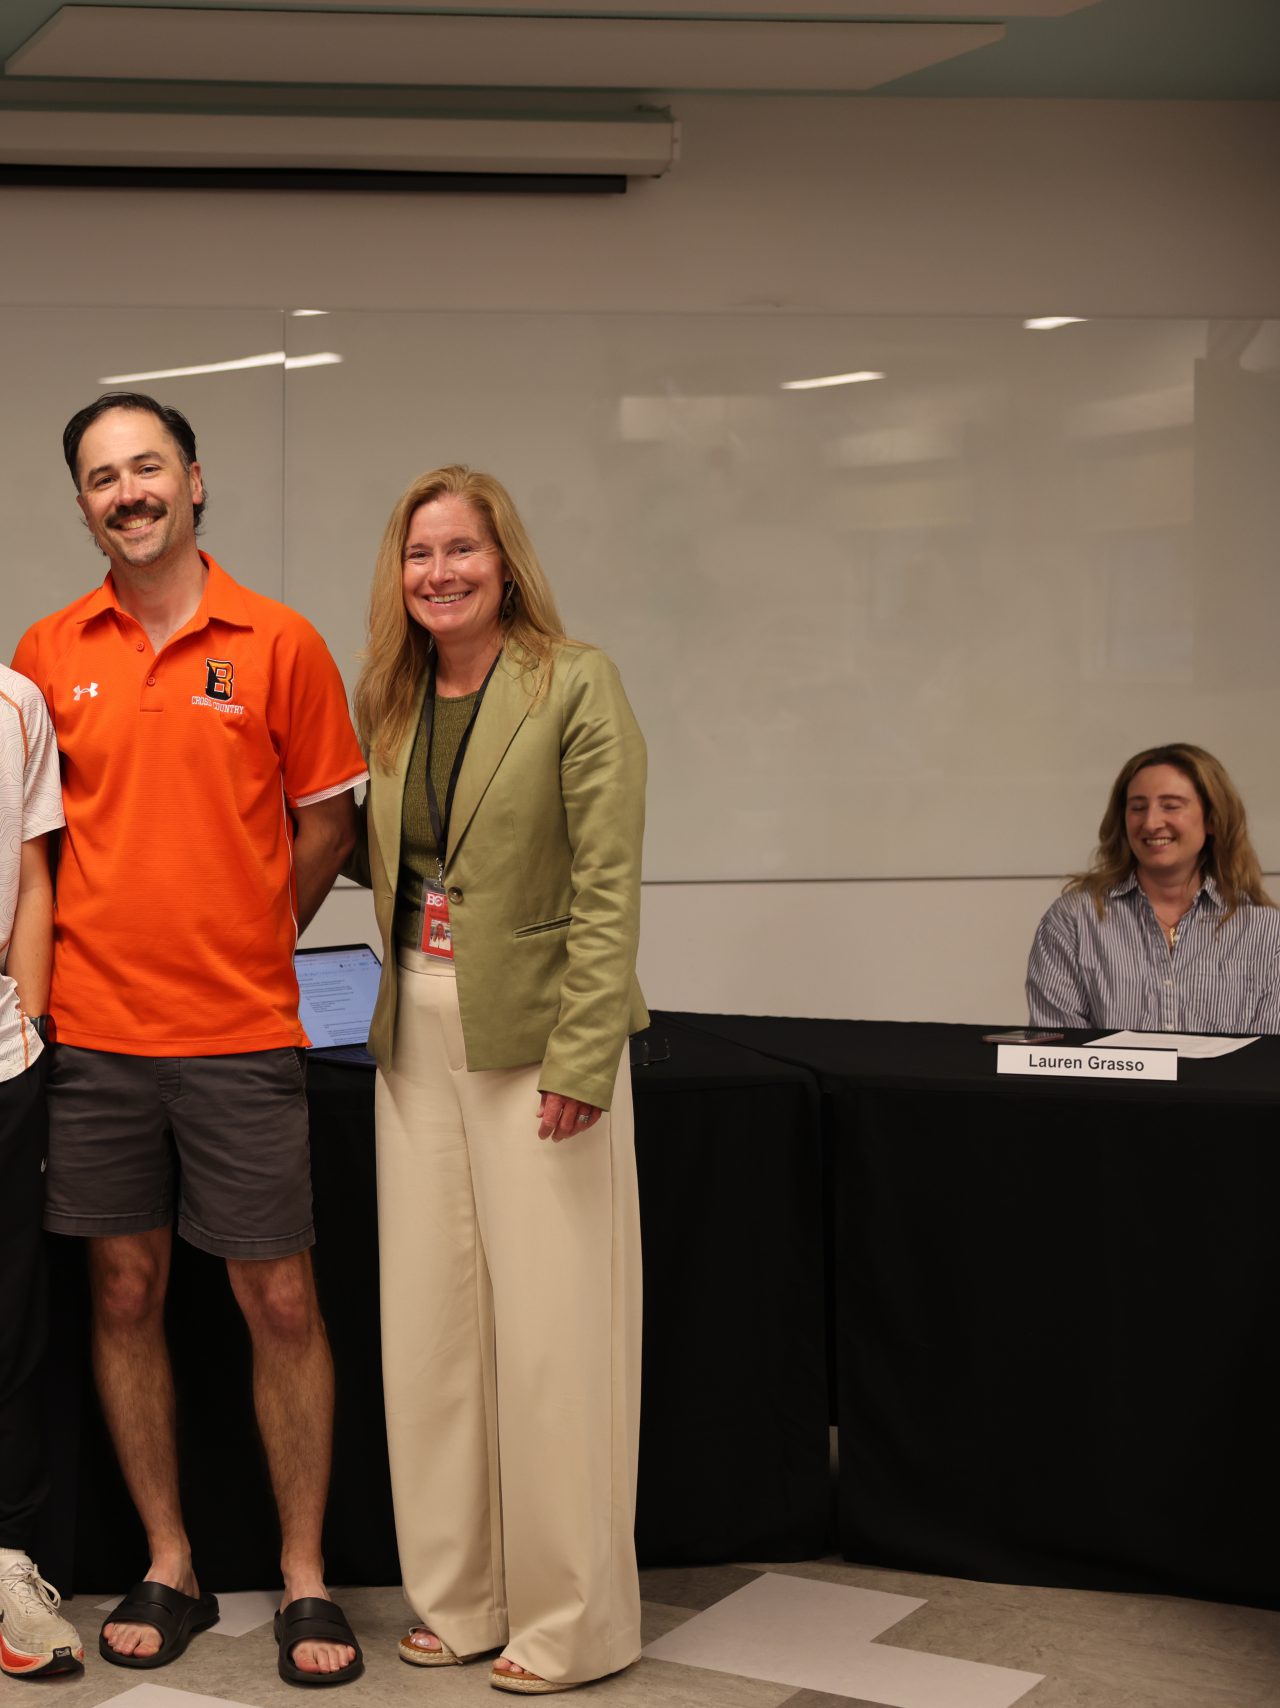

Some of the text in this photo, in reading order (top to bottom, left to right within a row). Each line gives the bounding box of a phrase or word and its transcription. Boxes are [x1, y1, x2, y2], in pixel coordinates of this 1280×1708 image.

[205, 657, 234, 702] B
[213, 701, 244, 715] COUNTRY
[1028, 1053, 1145, 1072] Lauren Grasso
